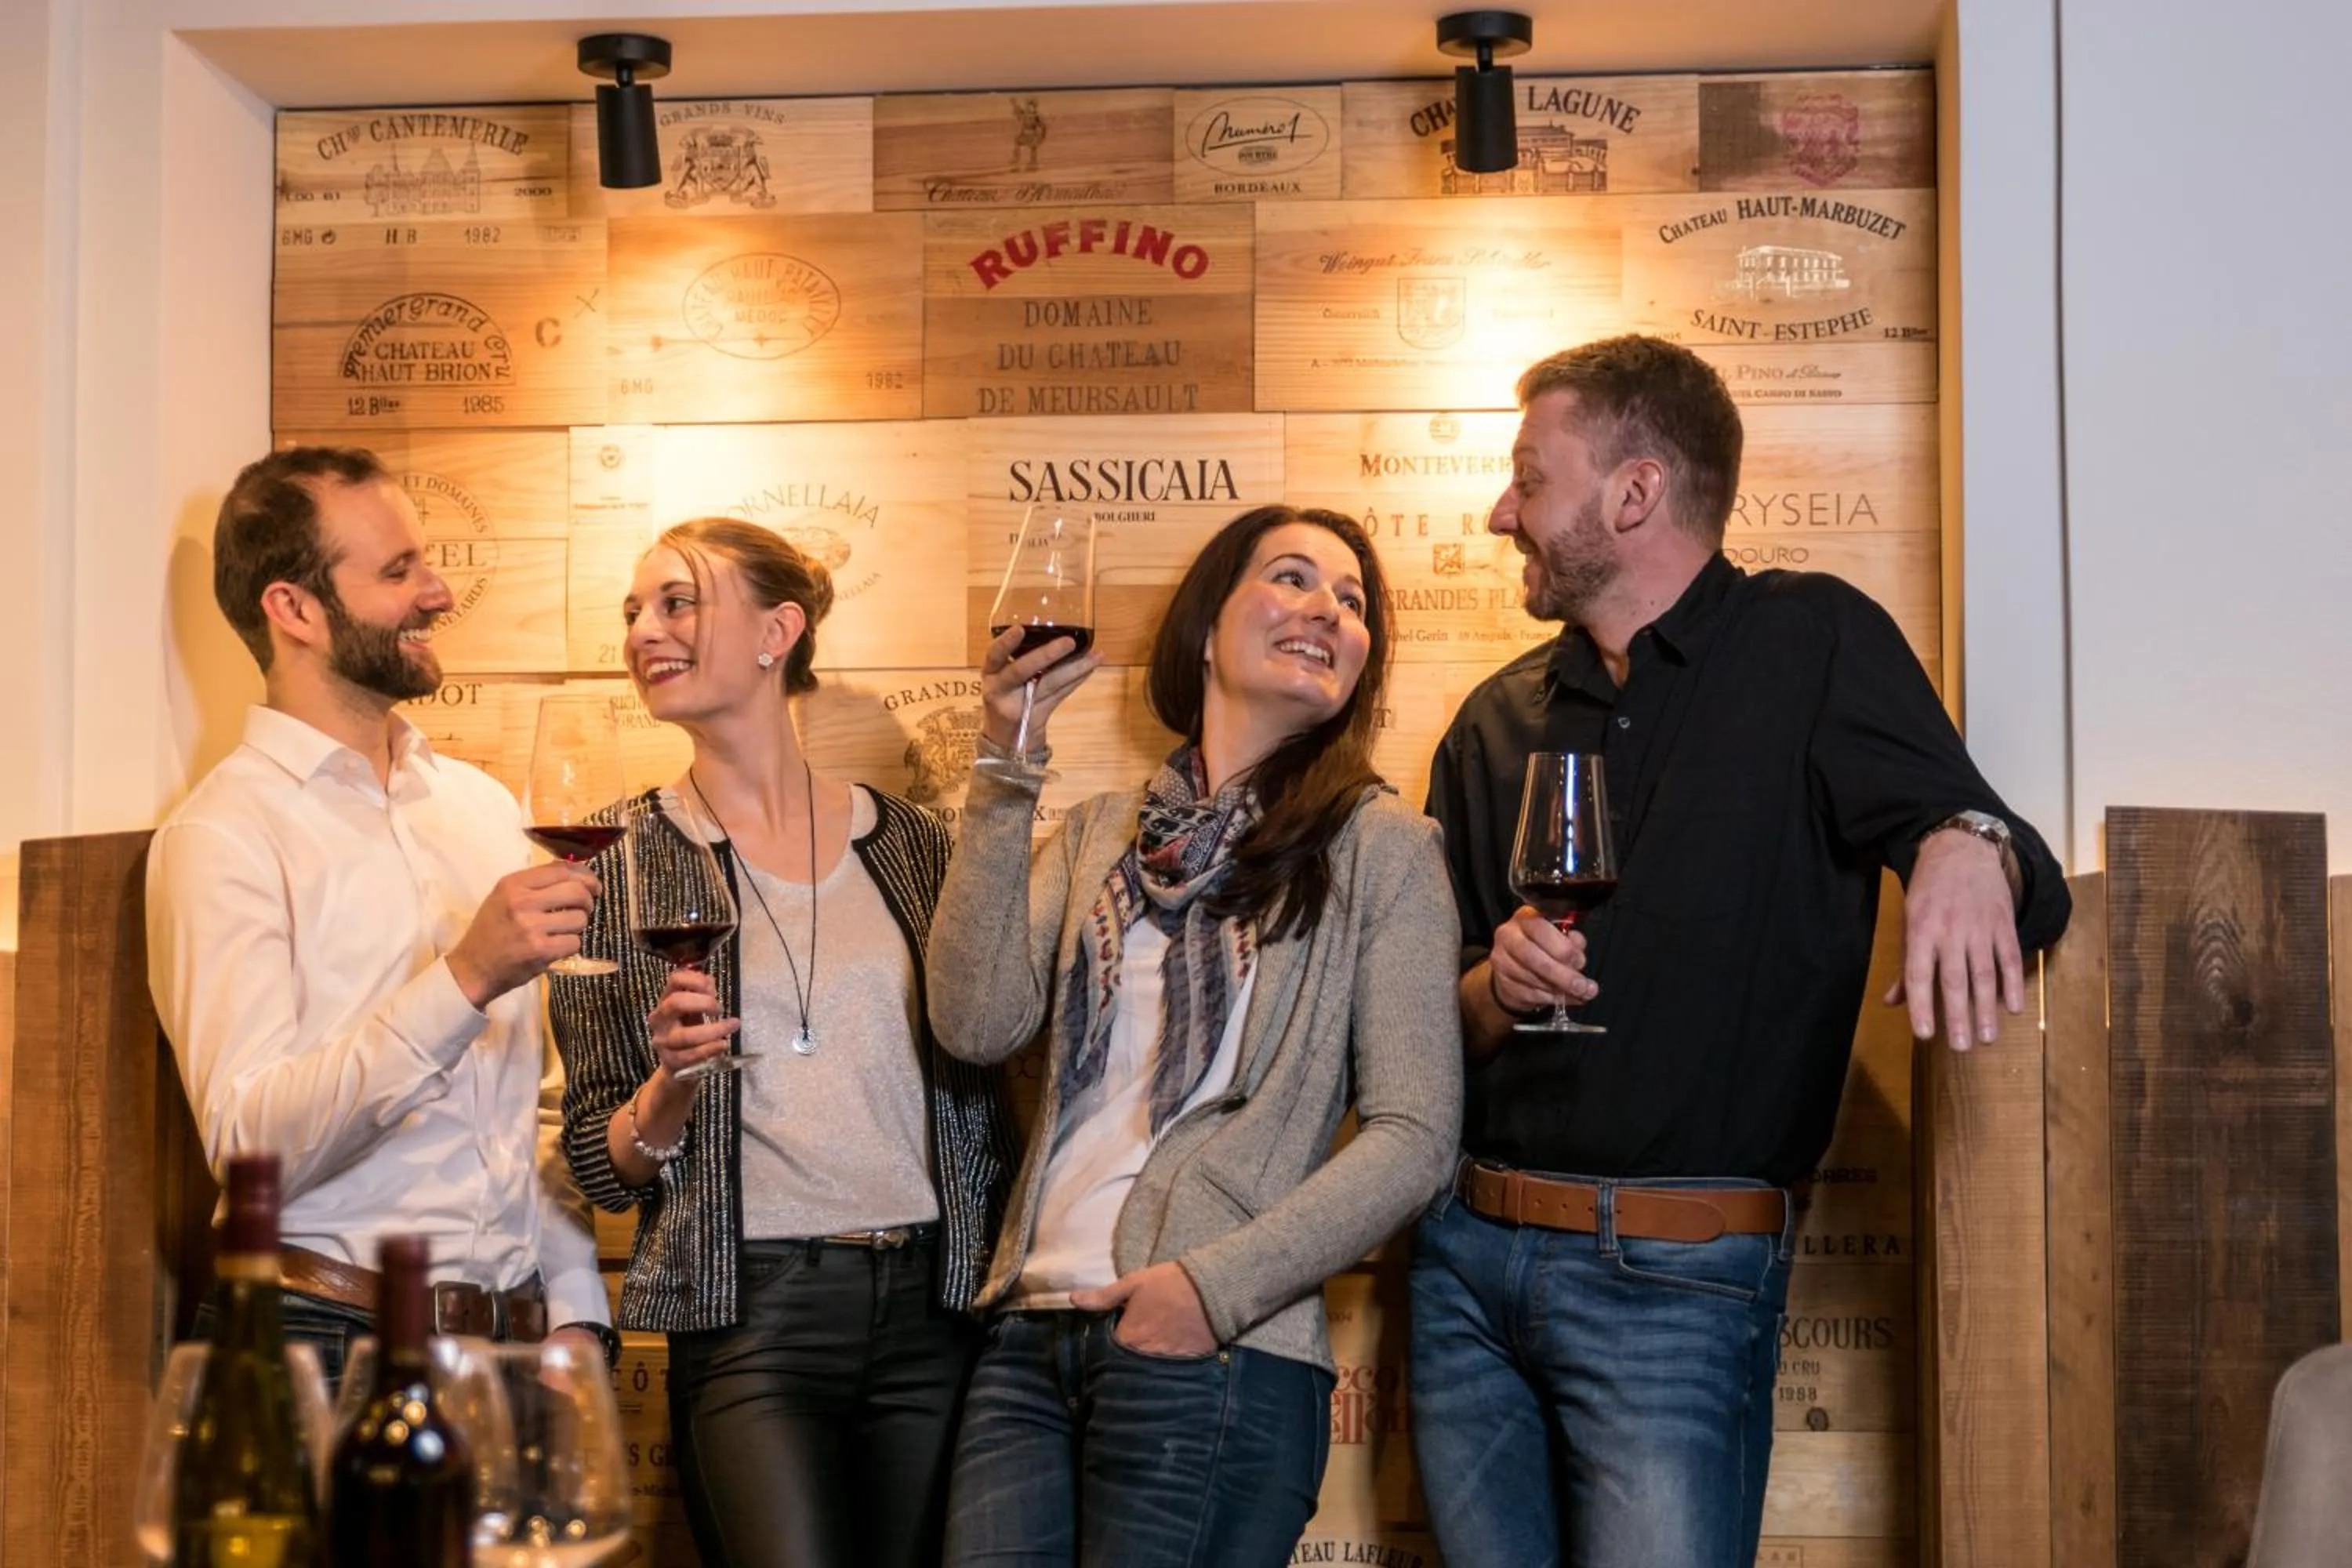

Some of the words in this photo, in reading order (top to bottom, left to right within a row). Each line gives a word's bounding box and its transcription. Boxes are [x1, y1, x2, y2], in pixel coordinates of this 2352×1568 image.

[659, 102, 731, 127] GRANDS
[743, 103, 786, 125] VINS
[1527, 85, 1642, 134] LAGUNE
[369, 113, 529, 156] CANTEMERLE
[1214, 180, 1302, 194] BORDEAUX
[1736, 195, 1907, 241] HAUT-MARBUZET
[463, 227, 502, 245] 1982
[969, 219, 1210, 290] RUFFINO
[1024, 297, 1154, 328] DOMAINE
[374, 339, 477, 361] CHATEAU
[996, 342, 1035, 372] DU
[1047, 339, 1182, 371] CHATEAU
[361, 362, 416, 383] HAUT
[424, 361, 493, 382] BRION
[1736, 364, 1784, 380] PINO
[347, 395, 365, 416] 12
[462, 394, 506, 414] 1985
[978, 387, 1016, 414] DE
[1027, 383, 1200, 414] MEURSAULT
[1008, 458, 1241, 503] SASSICAIA
[1363, 506, 1430, 538] ÔTE
[1727, 493, 1879, 526] RYSEIA
[884, 680, 982, 712] GRANDS
[1804, 1234, 1902, 1256] LLERA
[1778, 1316, 1894, 1350] SCOURS
